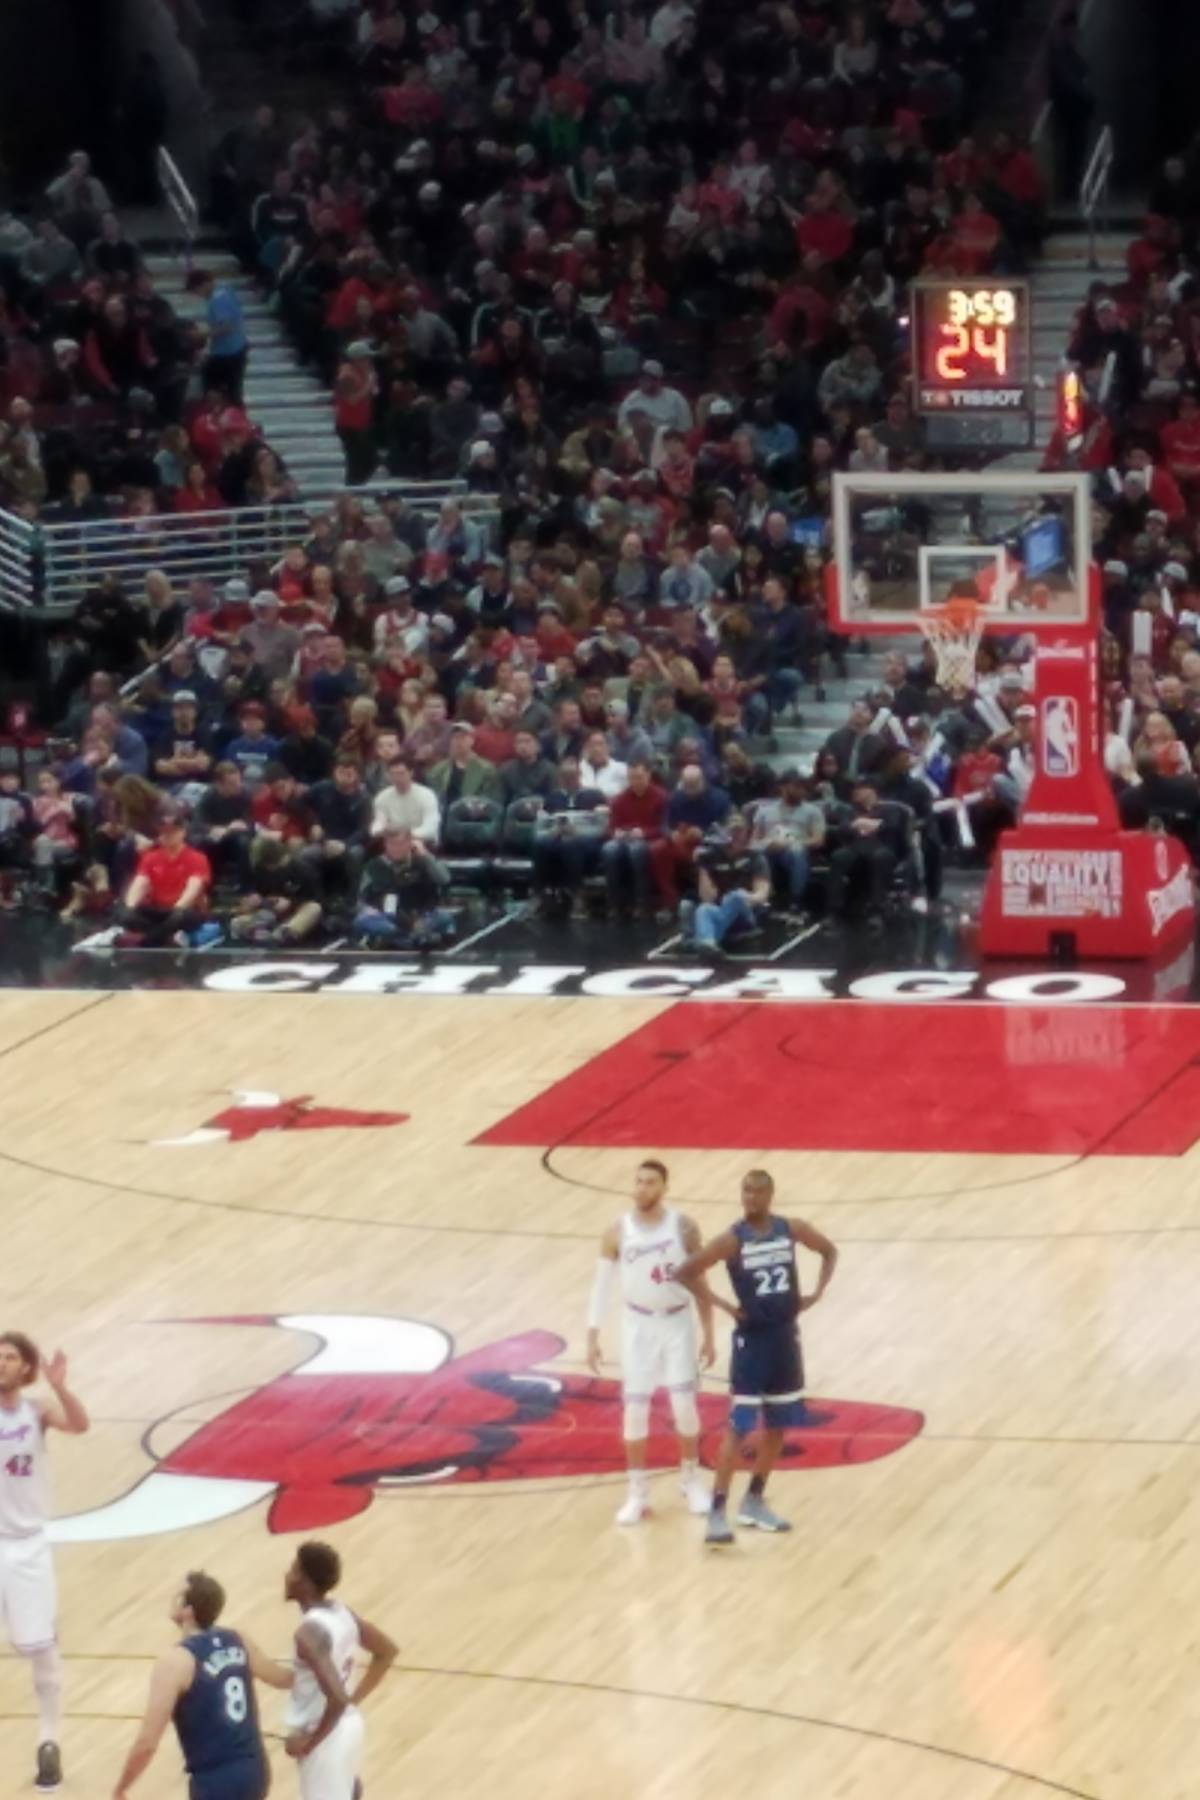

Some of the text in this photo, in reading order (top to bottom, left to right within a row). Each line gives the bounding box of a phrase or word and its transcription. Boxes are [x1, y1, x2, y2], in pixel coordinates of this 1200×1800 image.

[948, 289, 1016, 326] 3:59
[936, 323, 1006, 380] 24
[951, 389, 1024, 407] TISSOT
[1002, 861, 1110, 888] EQUALITY
[203, 963, 1126, 1001] CHICAGO
[753, 1265, 790, 1297] 22
[5, 1453, 33, 1477] 42
[224, 1675, 248, 1723] 8
